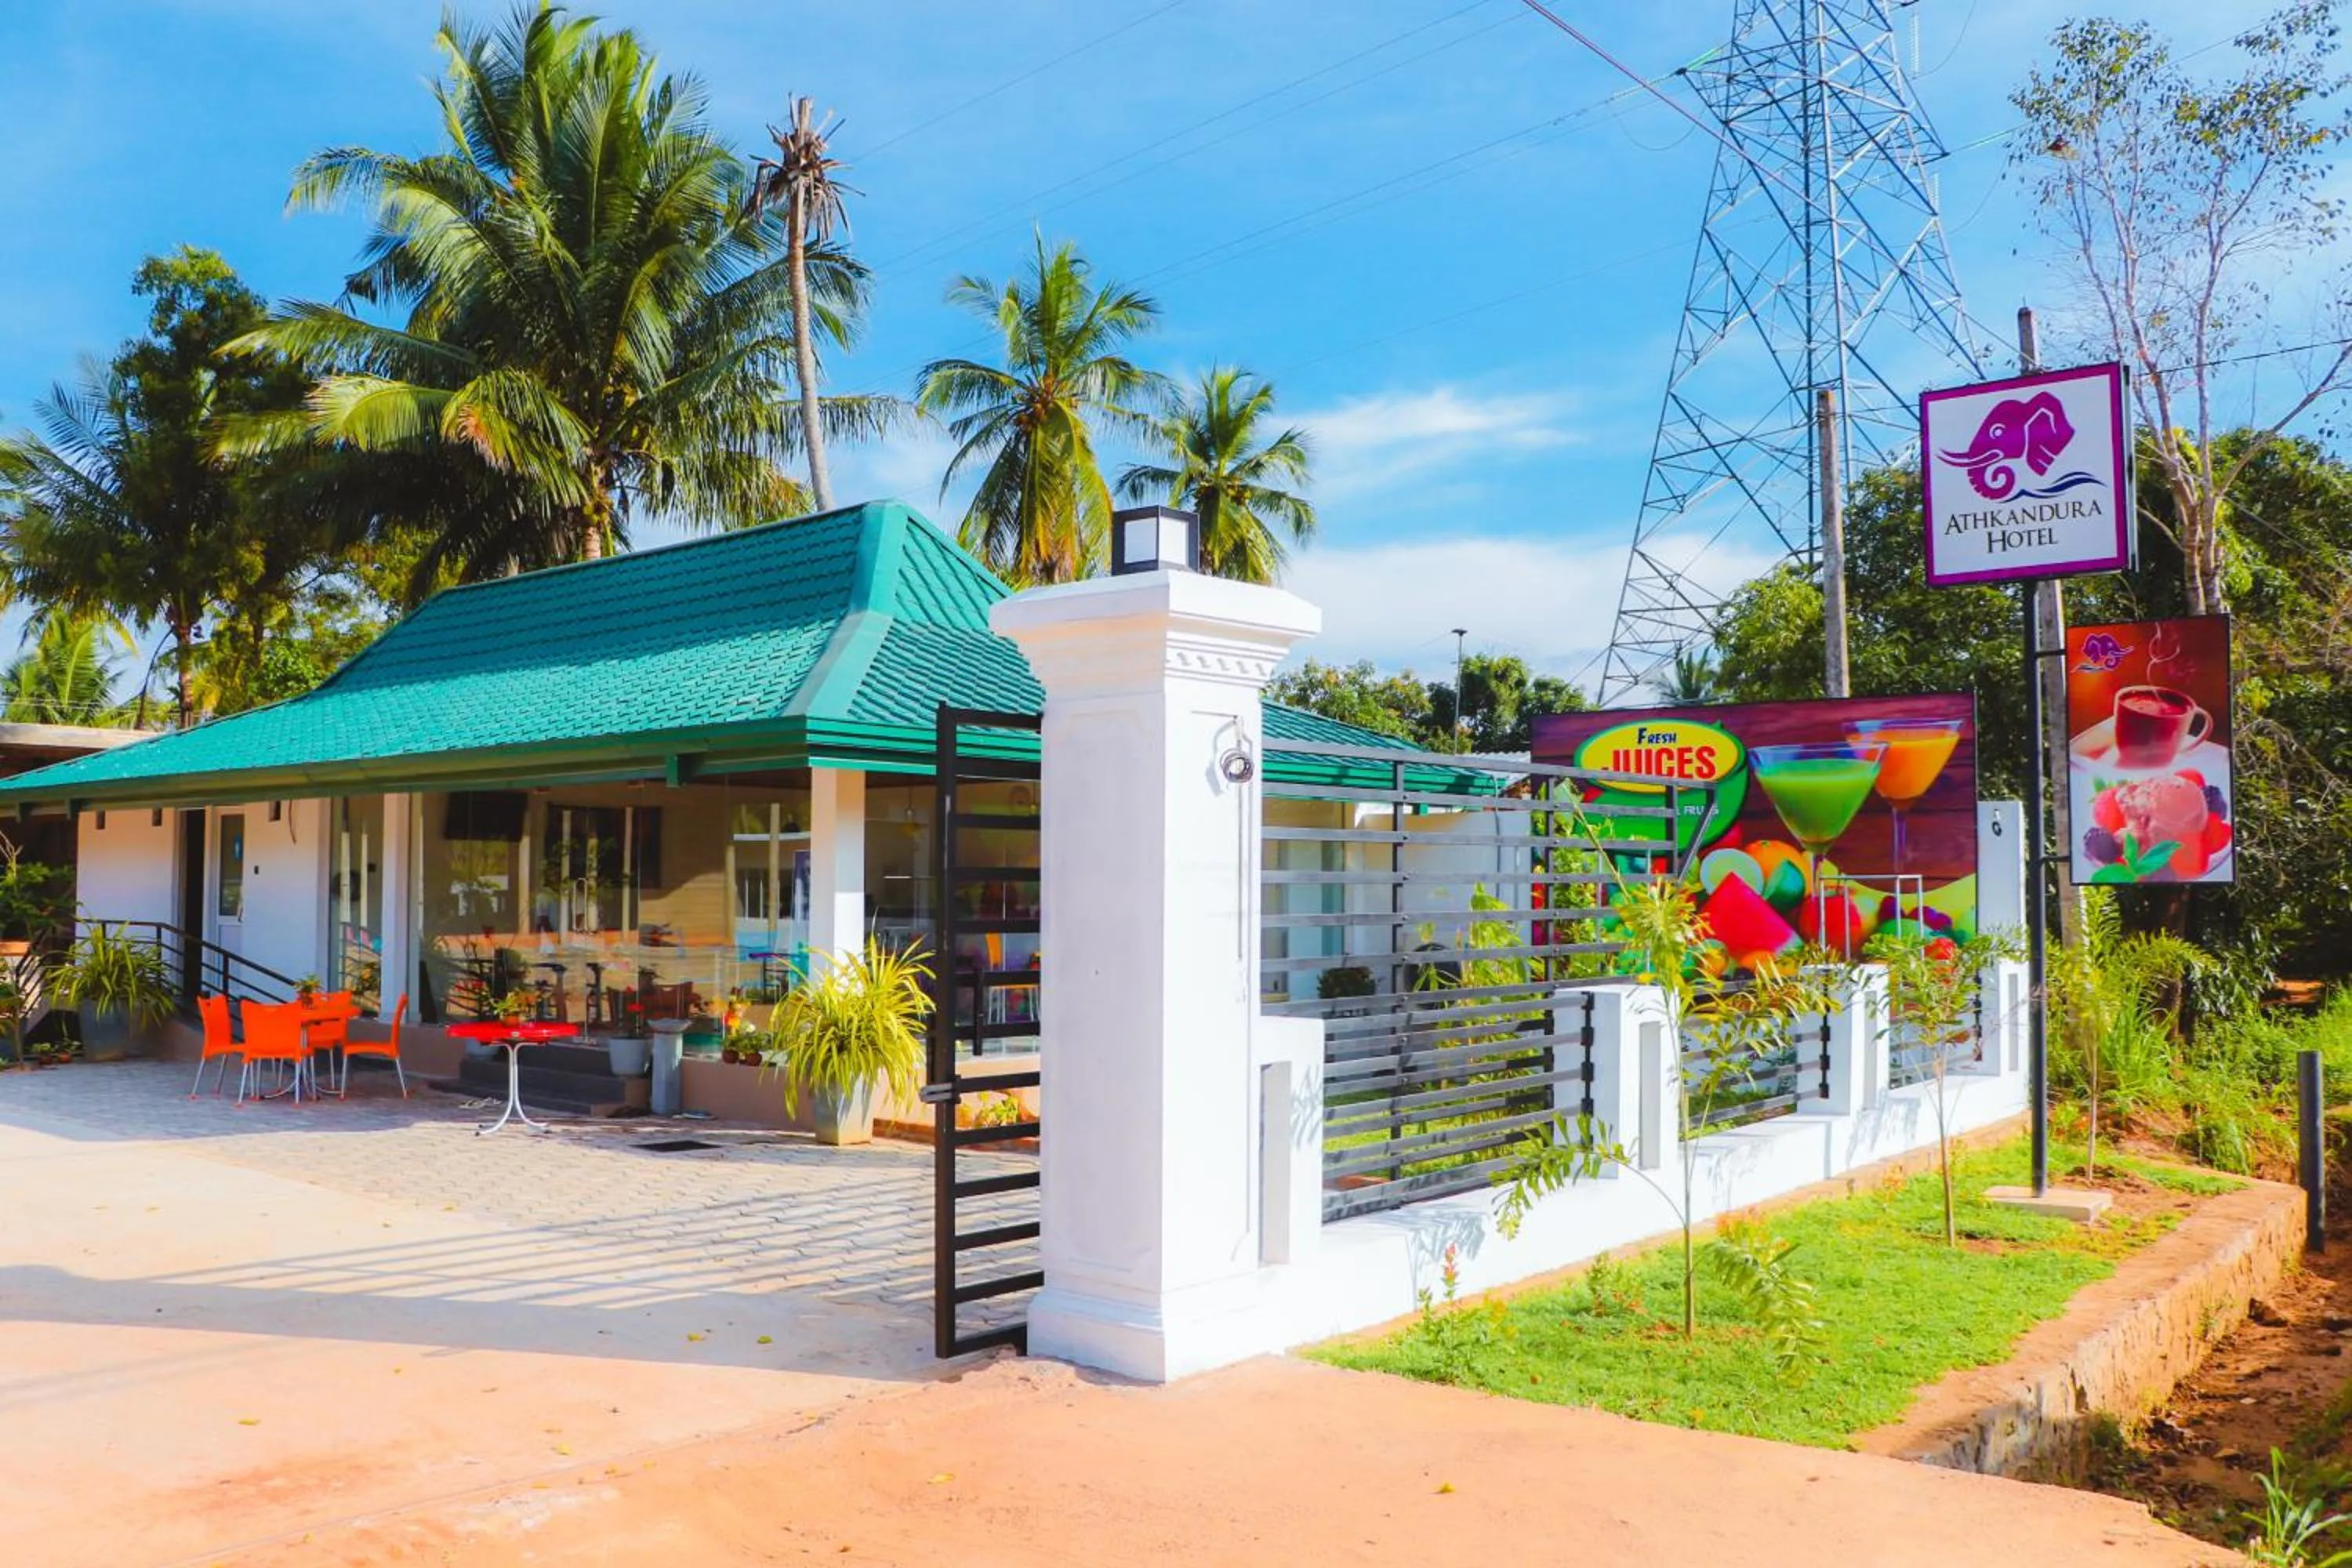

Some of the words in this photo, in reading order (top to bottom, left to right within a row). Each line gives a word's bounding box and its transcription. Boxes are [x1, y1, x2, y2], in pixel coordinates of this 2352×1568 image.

[1944, 499, 2103, 535] ATHKANDURA
[1986, 528, 2058, 554] HOTEL
[1637, 728, 1677, 744] FRESH
[1600, 746, 1716, 779] JUICES
